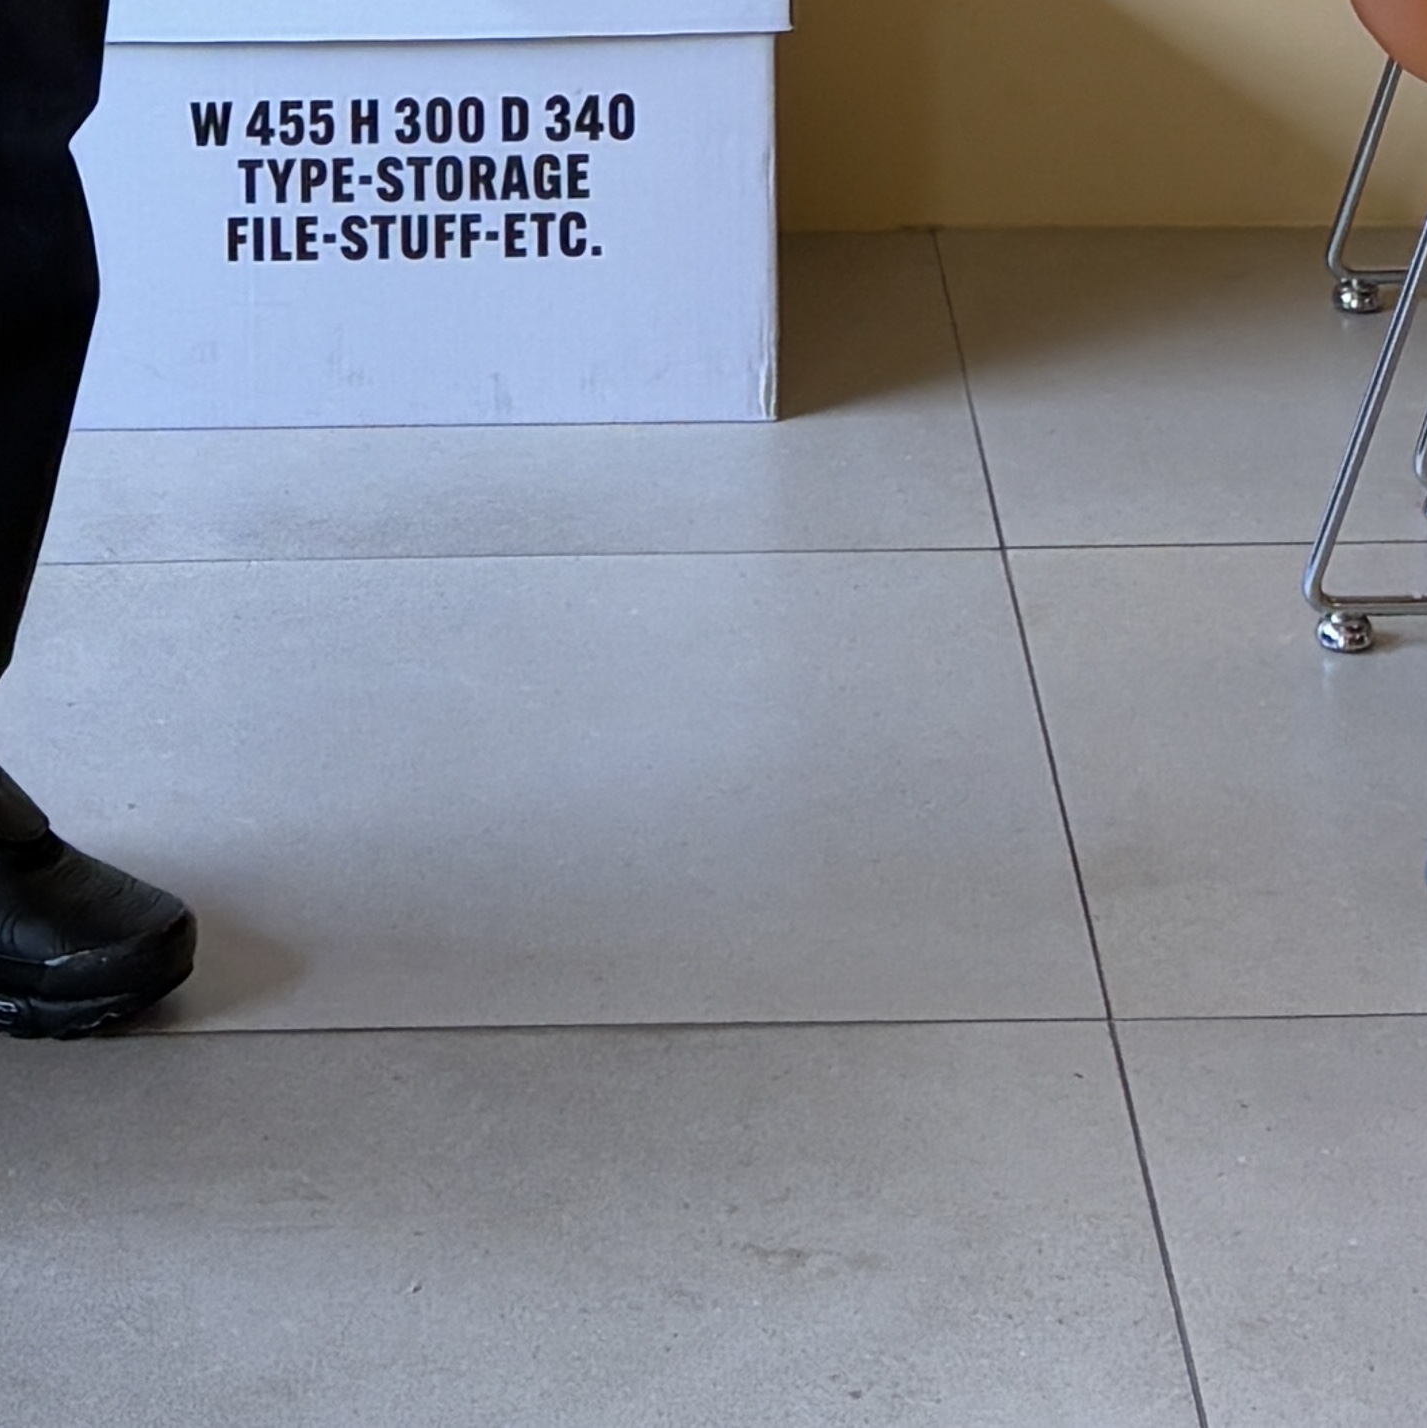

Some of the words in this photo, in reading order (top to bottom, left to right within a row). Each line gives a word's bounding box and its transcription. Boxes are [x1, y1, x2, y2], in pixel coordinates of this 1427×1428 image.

[191, 102, 233, 147] W
[245, 100, 335, 146] 455
[351, 99, 378, 145] H
[394, 97, 485, 144] 300
[502, 96, 531, 141] D
[544, 93, 635, 142] 340
[238, 154, 591, 204] TYPE-STORAGE
[226, 212, 602, 263] FILE-STUFF-ETC.
